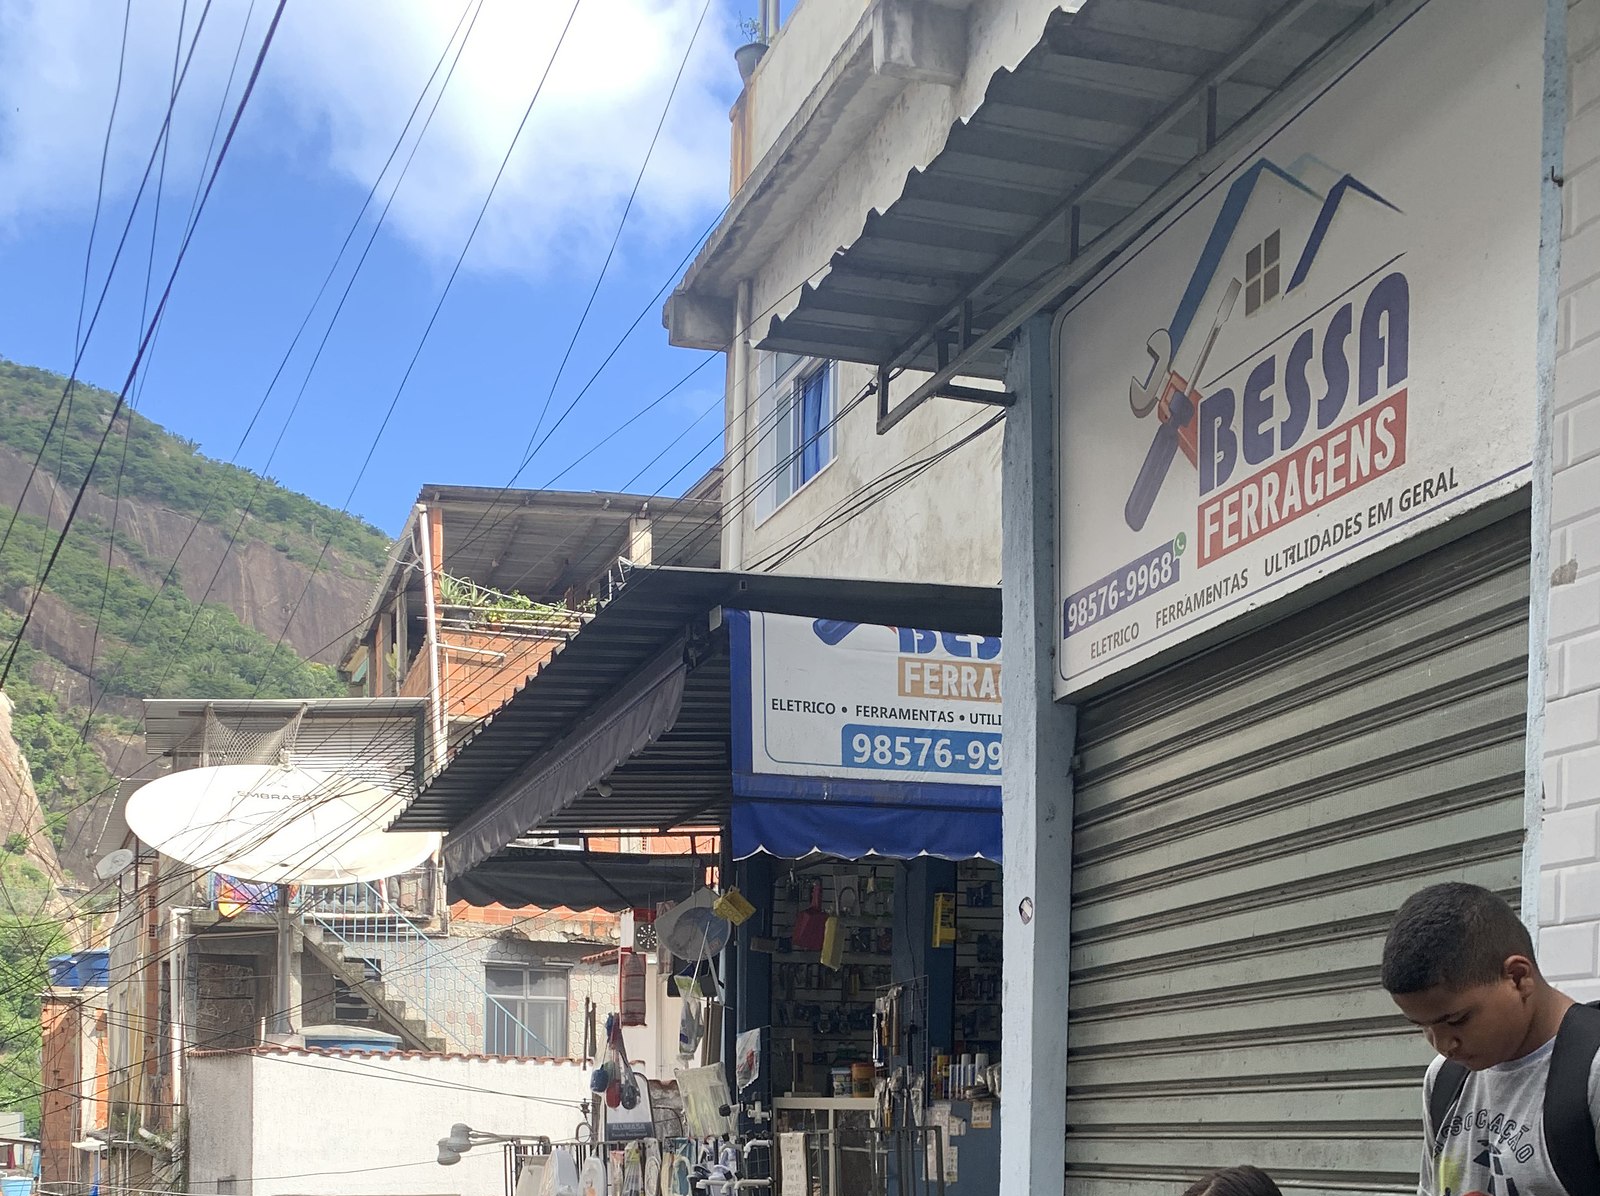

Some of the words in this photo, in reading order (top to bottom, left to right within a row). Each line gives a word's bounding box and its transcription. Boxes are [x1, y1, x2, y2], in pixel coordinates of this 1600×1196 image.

[1200, 272, 1409, 498] BESSA
[1202, 406, 1398, 560] FERRAGENS
[1067, 551, 1172, 633] 98576-9968
[1090, 621, 1140, 660] ELETRICO
[1155, 567, 1249, 630] FERRAMENTAS
[1367, 496, 1394, 529] EM
[1399, 466, 1459, 513] GERAL
[771, 698, 837, 715] ELETRICO
[855, 704, 955, 723] FERRAMENTAS
[904, 661, 1002, 699] FERRA
[852, 733, 1003, 771] 98576-99
